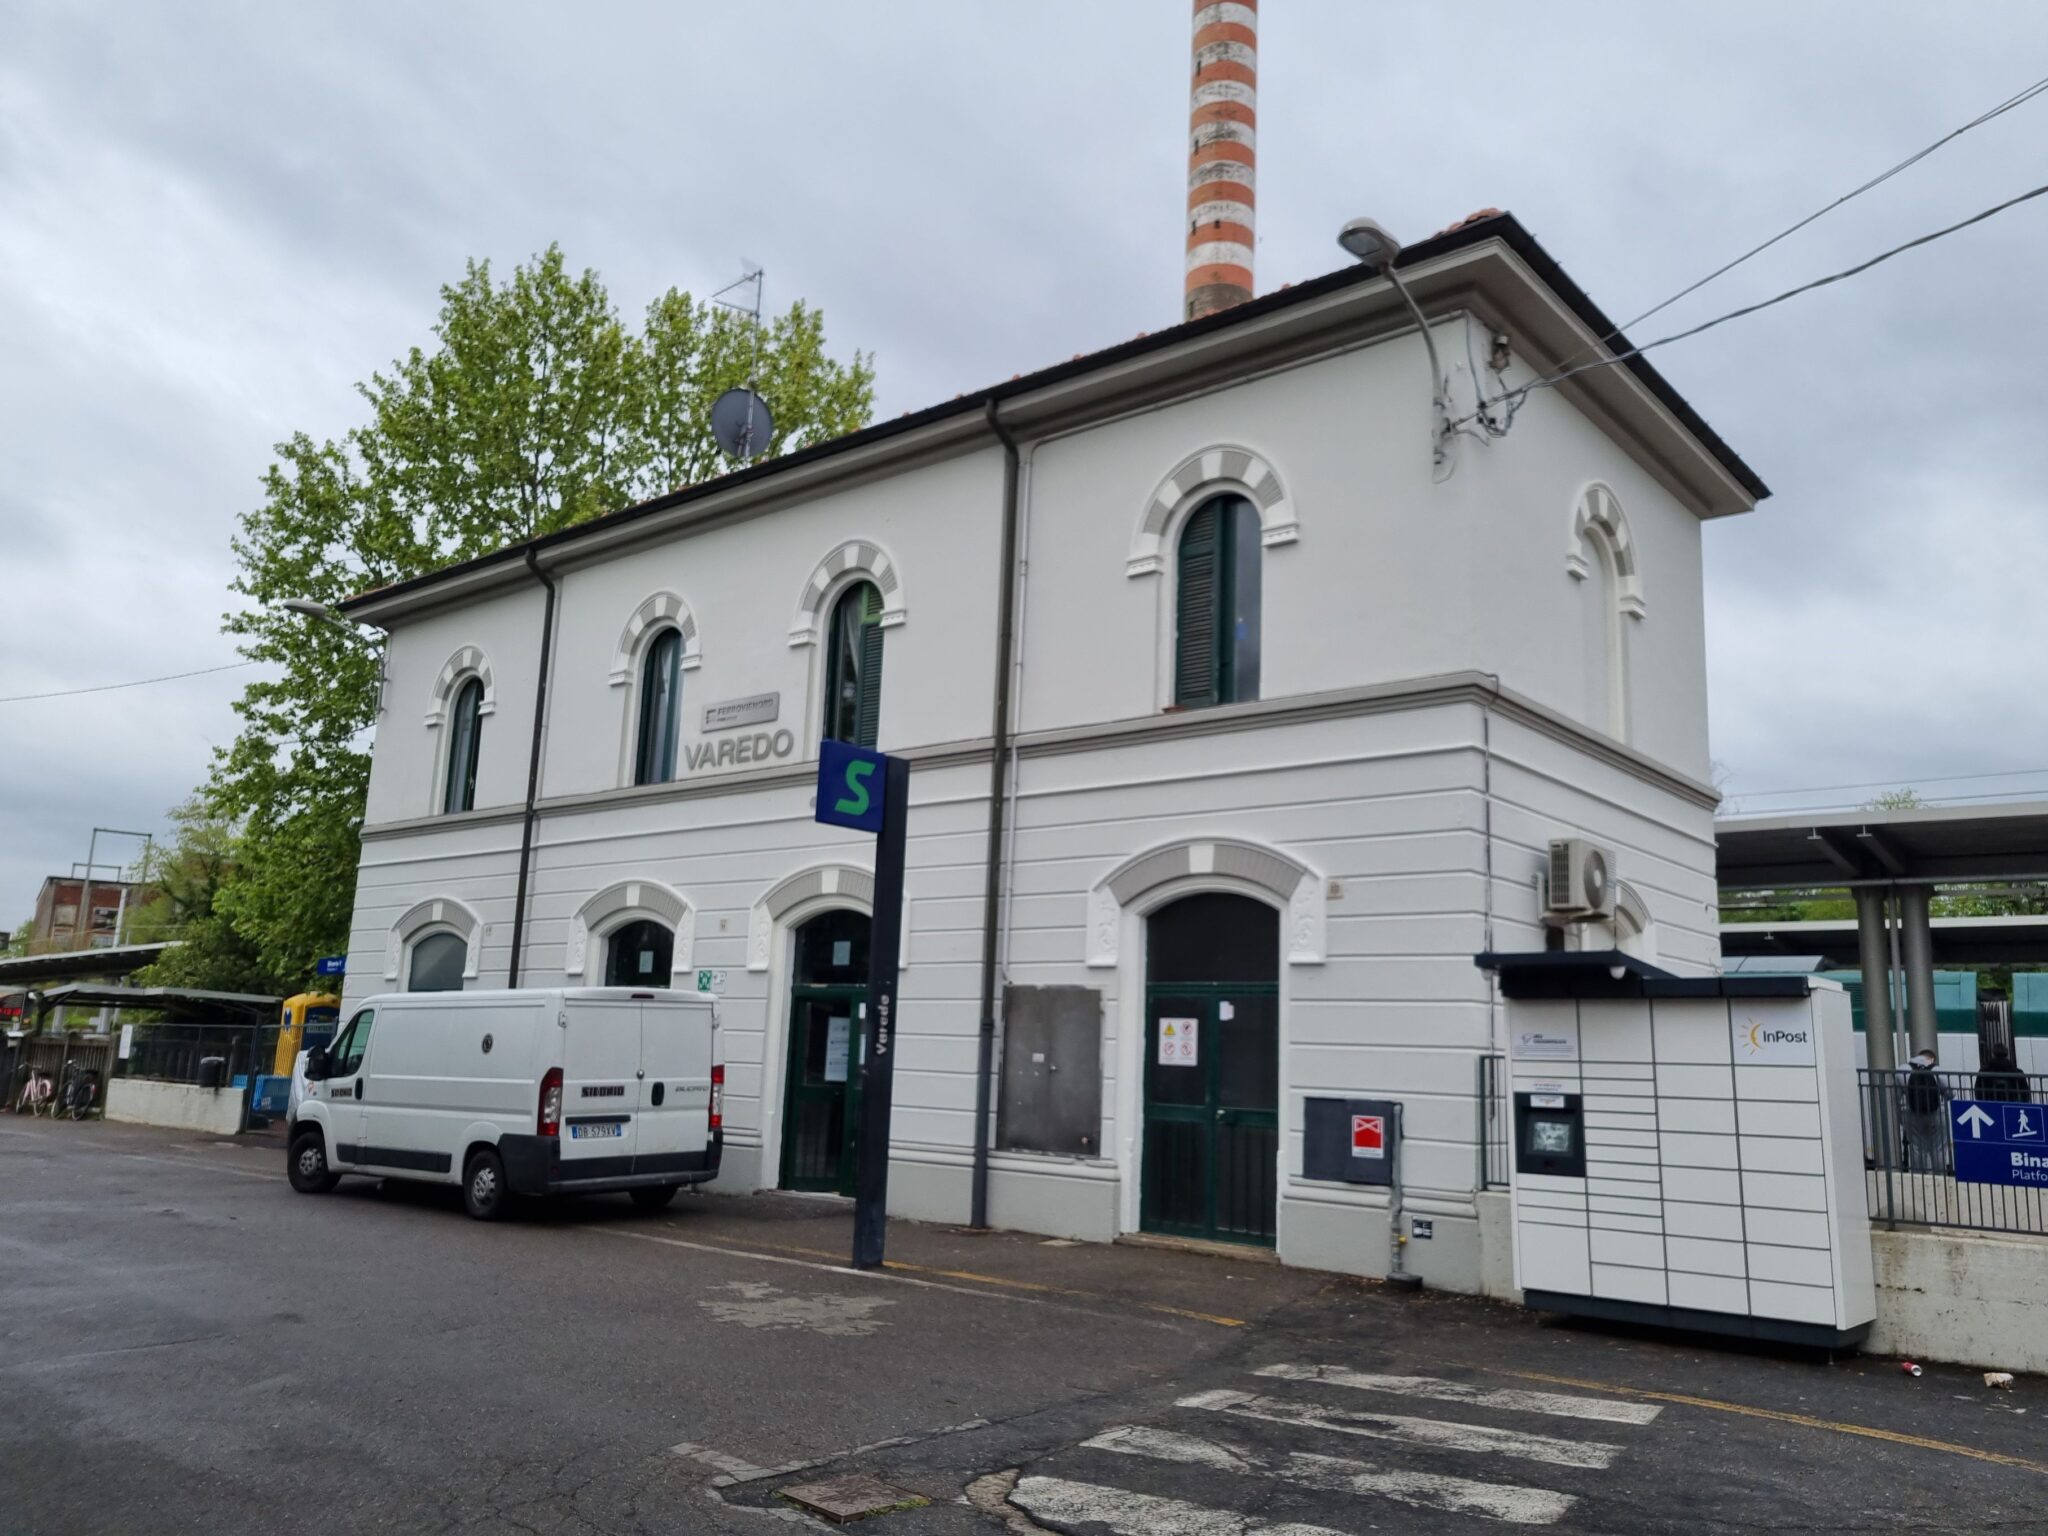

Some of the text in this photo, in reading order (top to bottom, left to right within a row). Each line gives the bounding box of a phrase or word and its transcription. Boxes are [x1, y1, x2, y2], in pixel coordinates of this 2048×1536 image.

[684, 728, 794, 771] VAREDO
[834, 760, 876, 816] S
[876, 994, 890, 1055] Varedo
[1763, 1030, 1807, 1043] InPost
